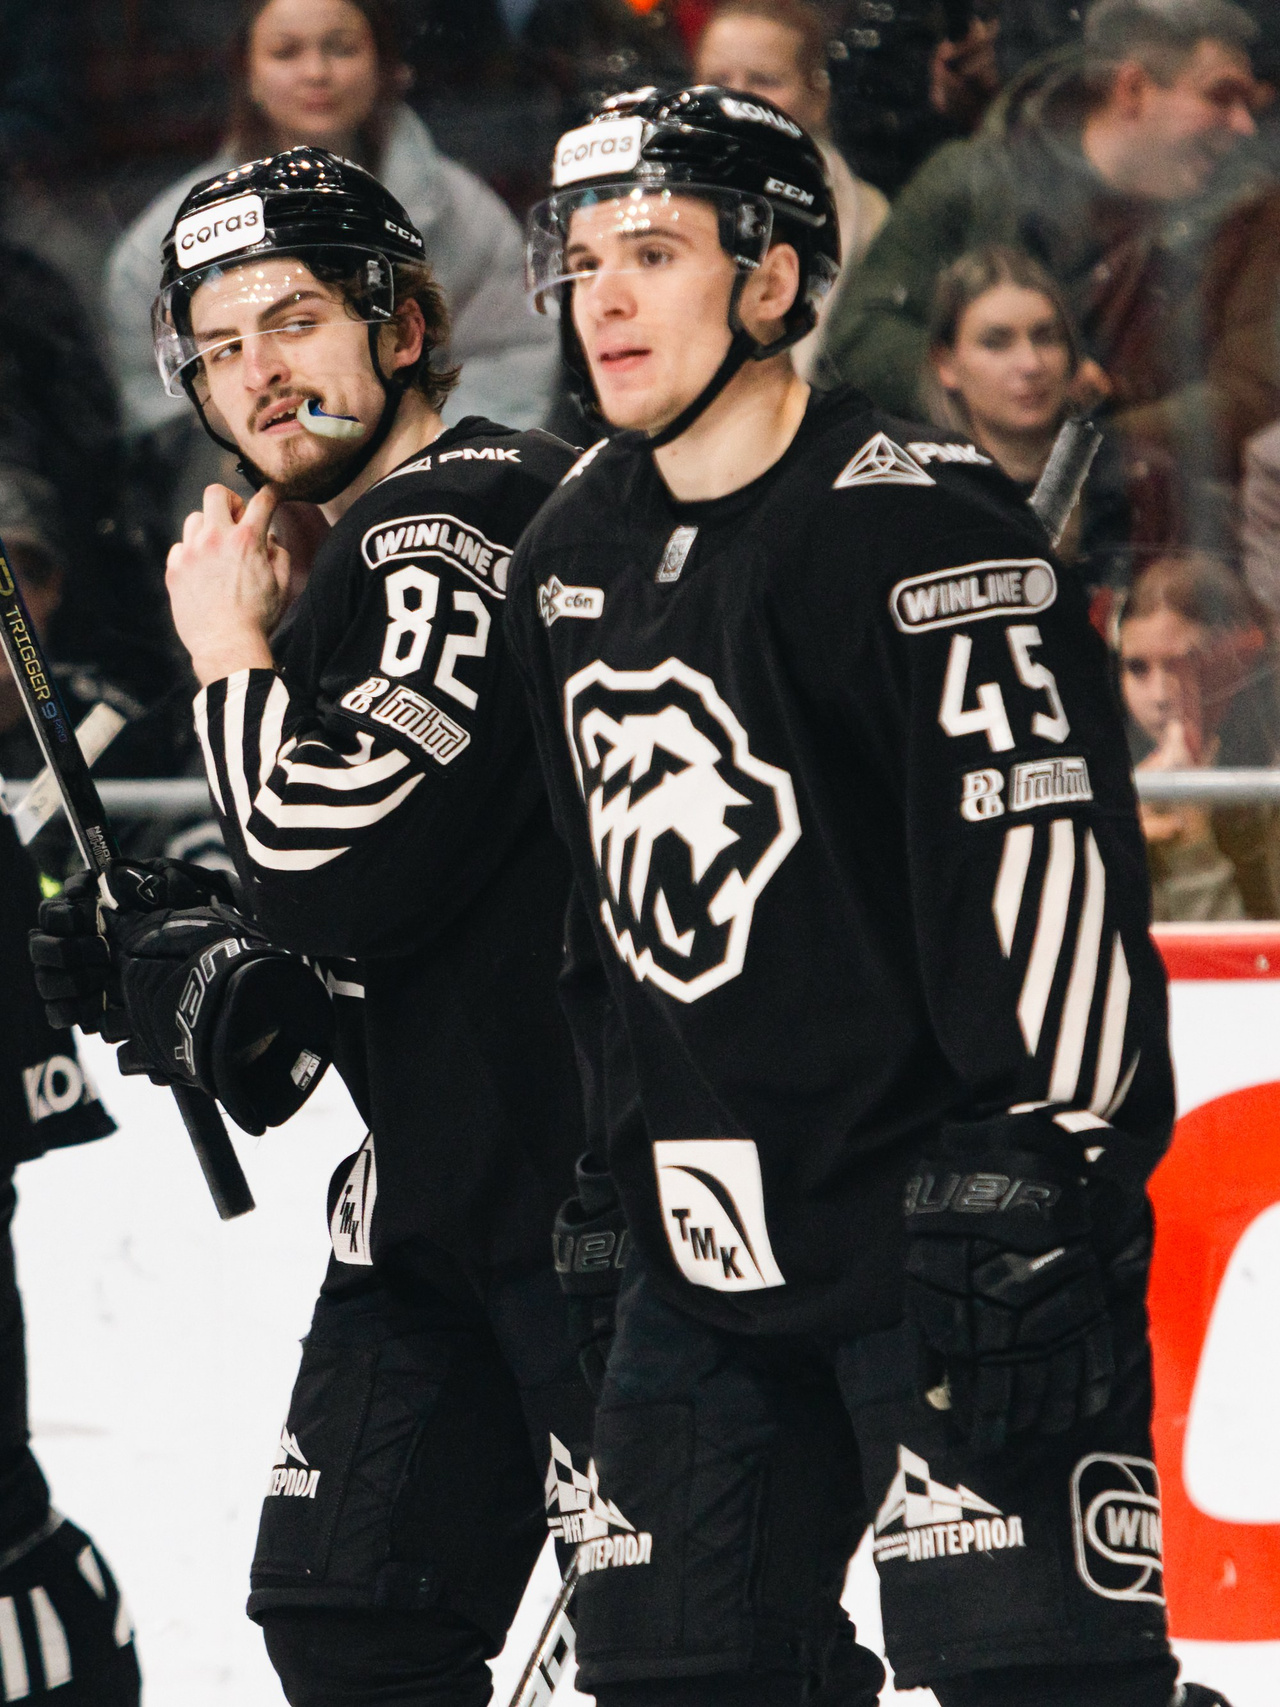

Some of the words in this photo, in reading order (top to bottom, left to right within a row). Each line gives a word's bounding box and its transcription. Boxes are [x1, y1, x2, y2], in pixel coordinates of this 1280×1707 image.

[560, 134, 634, 167] согаз
[764, 176, 815, 207] CCM
[180, 209, 260, 251] согаз
[384, 218, 423, 248] CCM
[374, 521, 494, 578] WINLINE
[901, 571, 1024, 624] WINLINE
[4, 604, 52, 701] TRIGGER
[40, 700, 59, 721] 9
[379, 564, 493, 711] 82
[938, 624, 1071, 753] 45
[670, 1207, 744, 1279] ТМК
[907, 1514, 1027, 1563] ИНТЕРПОЛ
